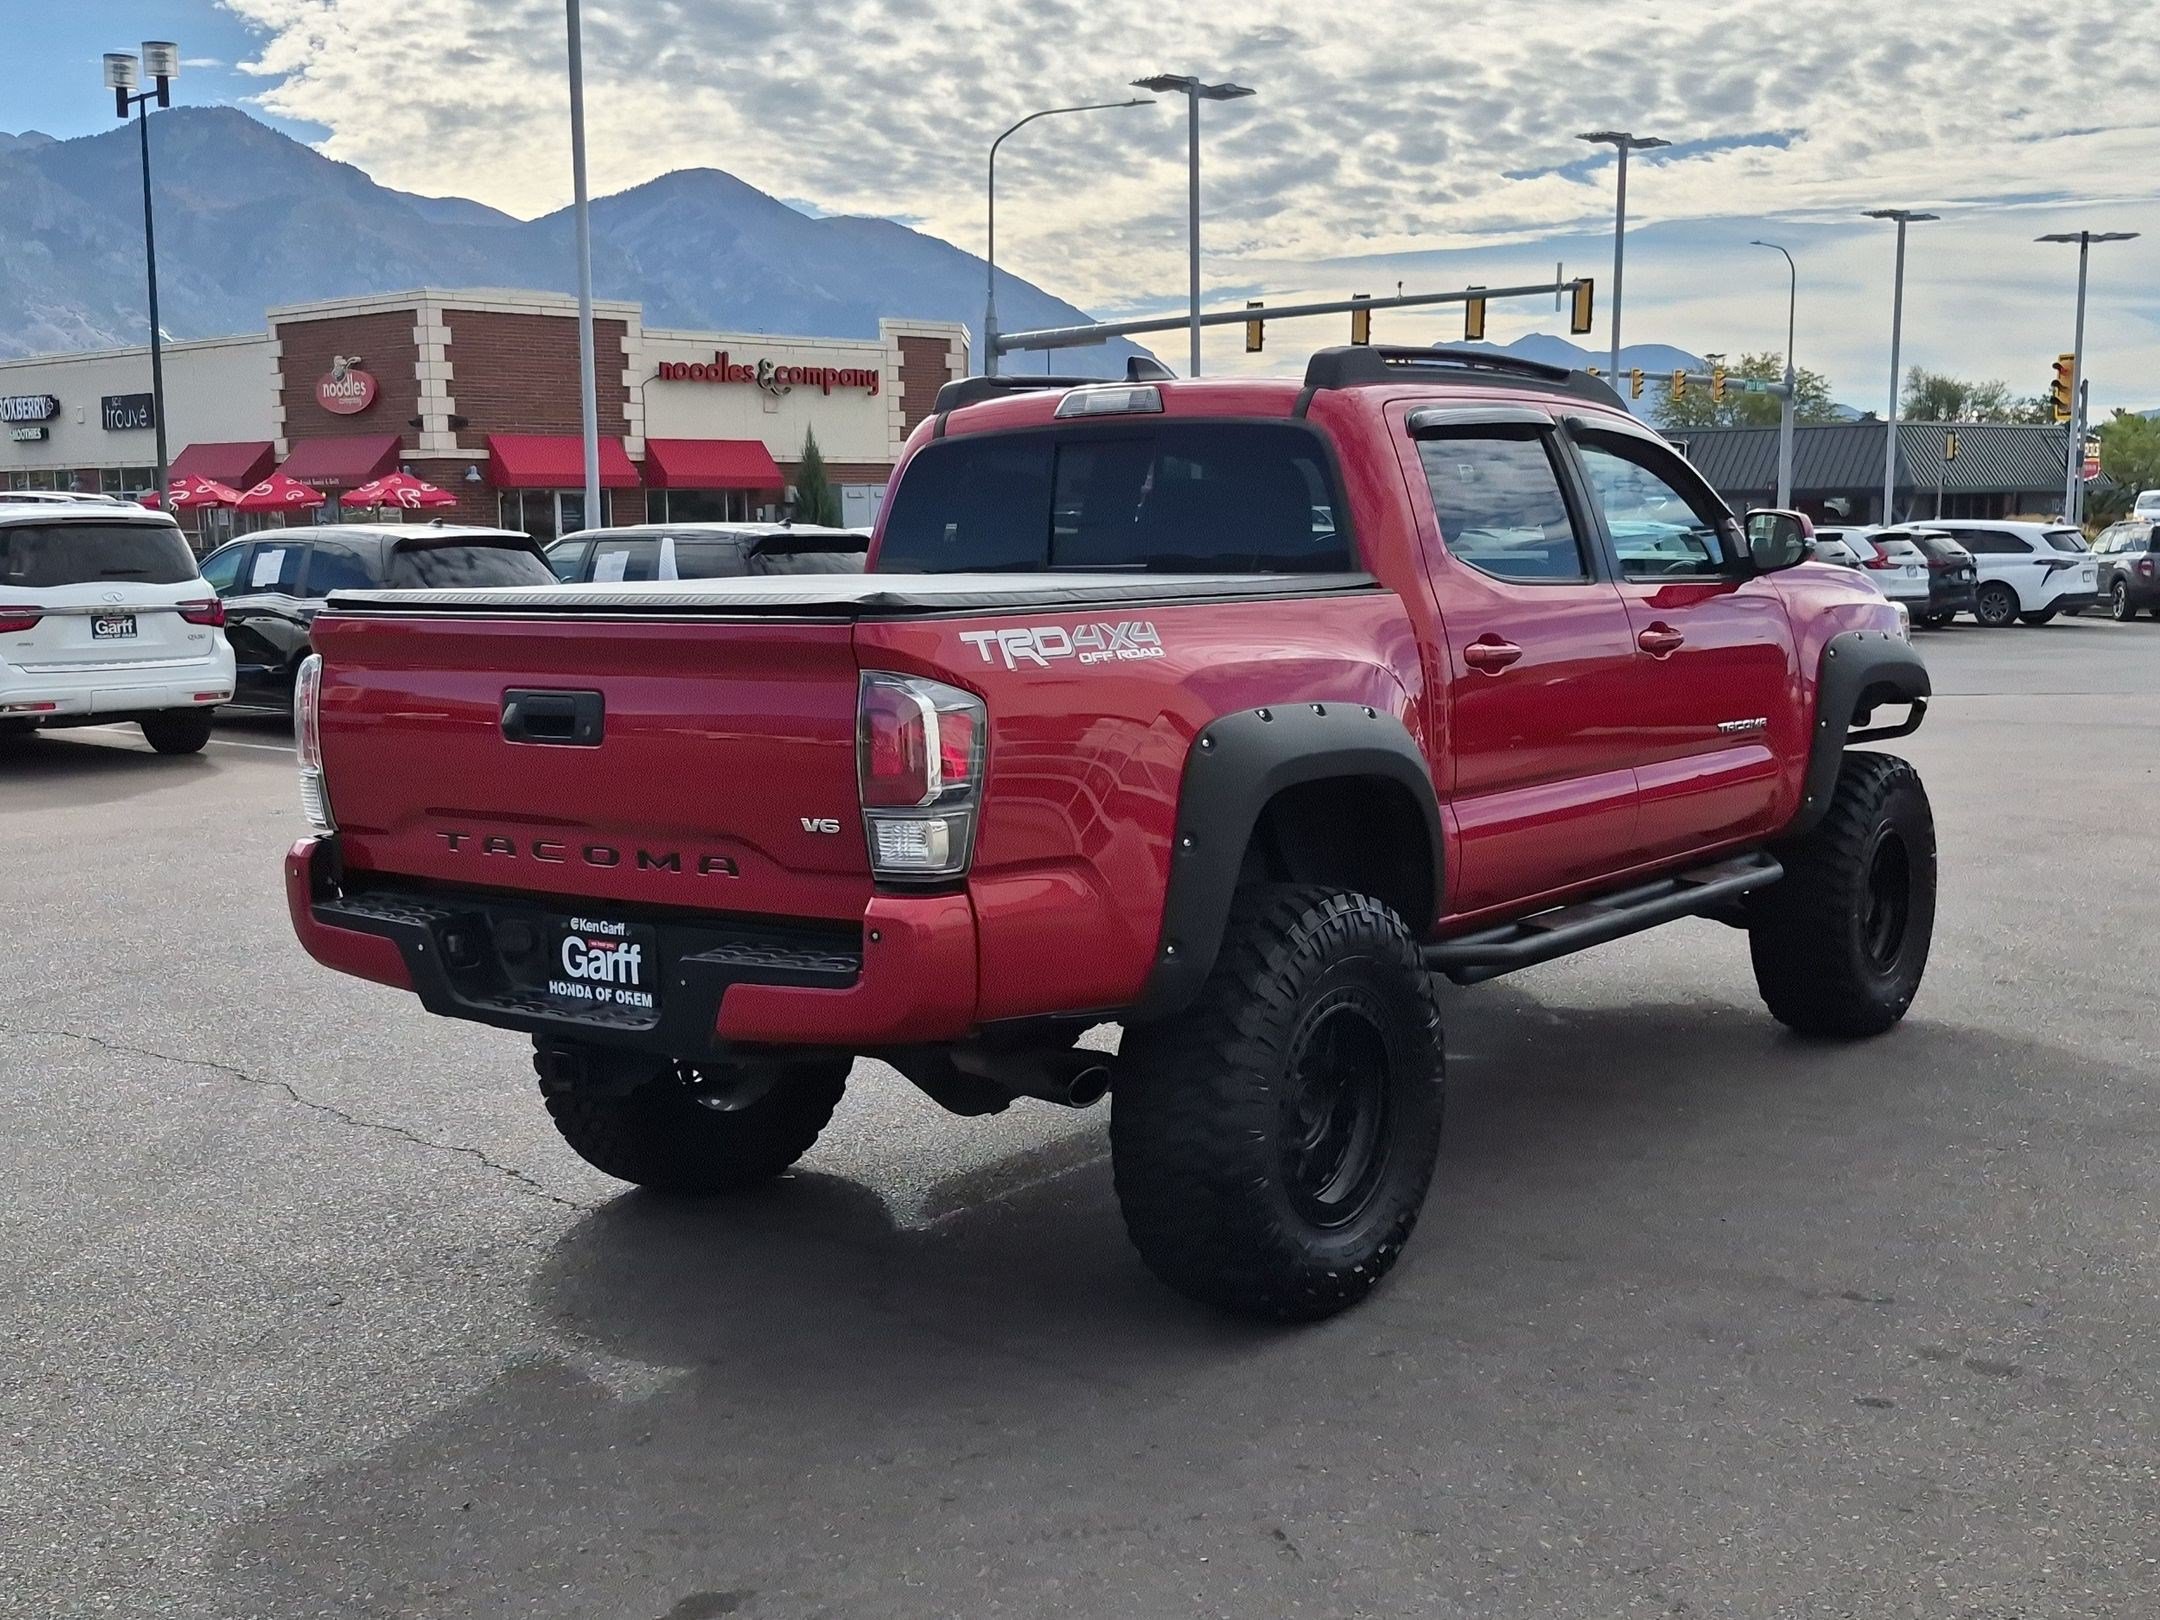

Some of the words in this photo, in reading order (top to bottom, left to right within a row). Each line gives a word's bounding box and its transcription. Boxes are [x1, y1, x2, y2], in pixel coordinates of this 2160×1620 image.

[322, 373, 367, 398] noodles
[659, 351, 755, 384] noodles
[757, 357, 791, 396] &
[774, 366, 880, 396] company
[105, 404, 147, 429] trouvé
[95, 619, 134, 635] Garff
[959, 626, 1075, 671] TRD
[1079, 650, 1114, 665] OFF
[1116, 646, 1165, 661] ROAD
[1717, 717, 1767, 733] TACOMA
[800, 817, 840, 834] V6
[436, 831, 740, 879] TACOMA
[561, 935, 641, 985] Garff
[548, 980, 593, 1000] HONDA
[595, 987, 612, 1002] OF
[615, 989, 653, 1008] OREM
